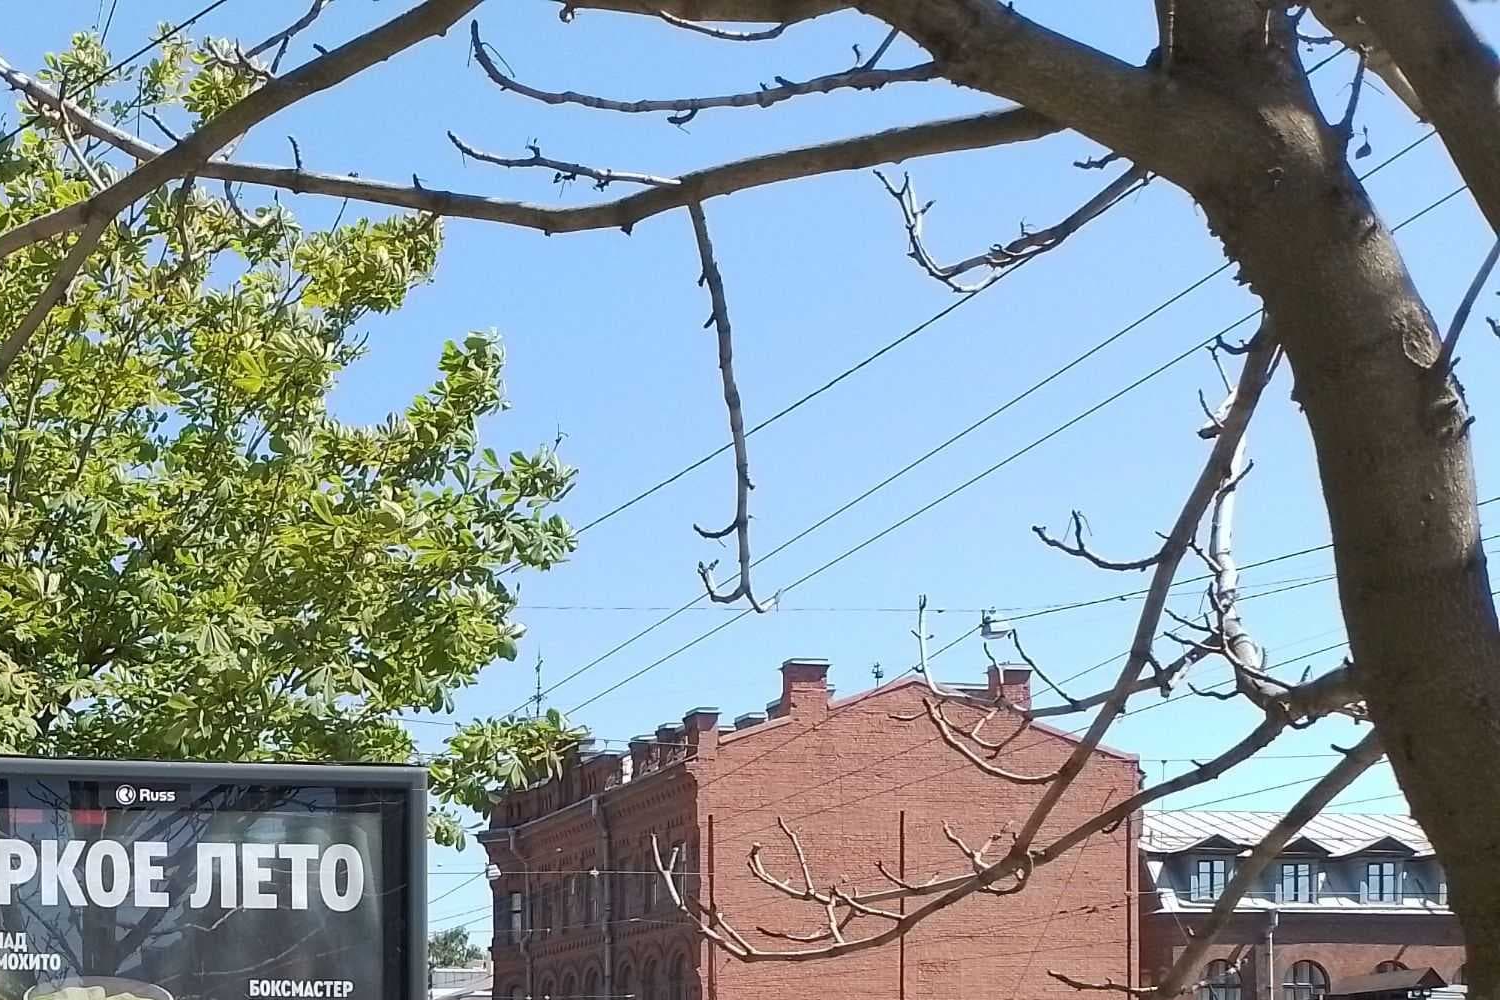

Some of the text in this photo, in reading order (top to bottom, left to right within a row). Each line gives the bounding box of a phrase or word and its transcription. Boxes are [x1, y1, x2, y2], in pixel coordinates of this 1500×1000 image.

[139, 788, 176, 802] Russ
[190, 842, 364, 912] ЛЕТО
[249, 979, 354, 998] БОКСМАСТЕР
